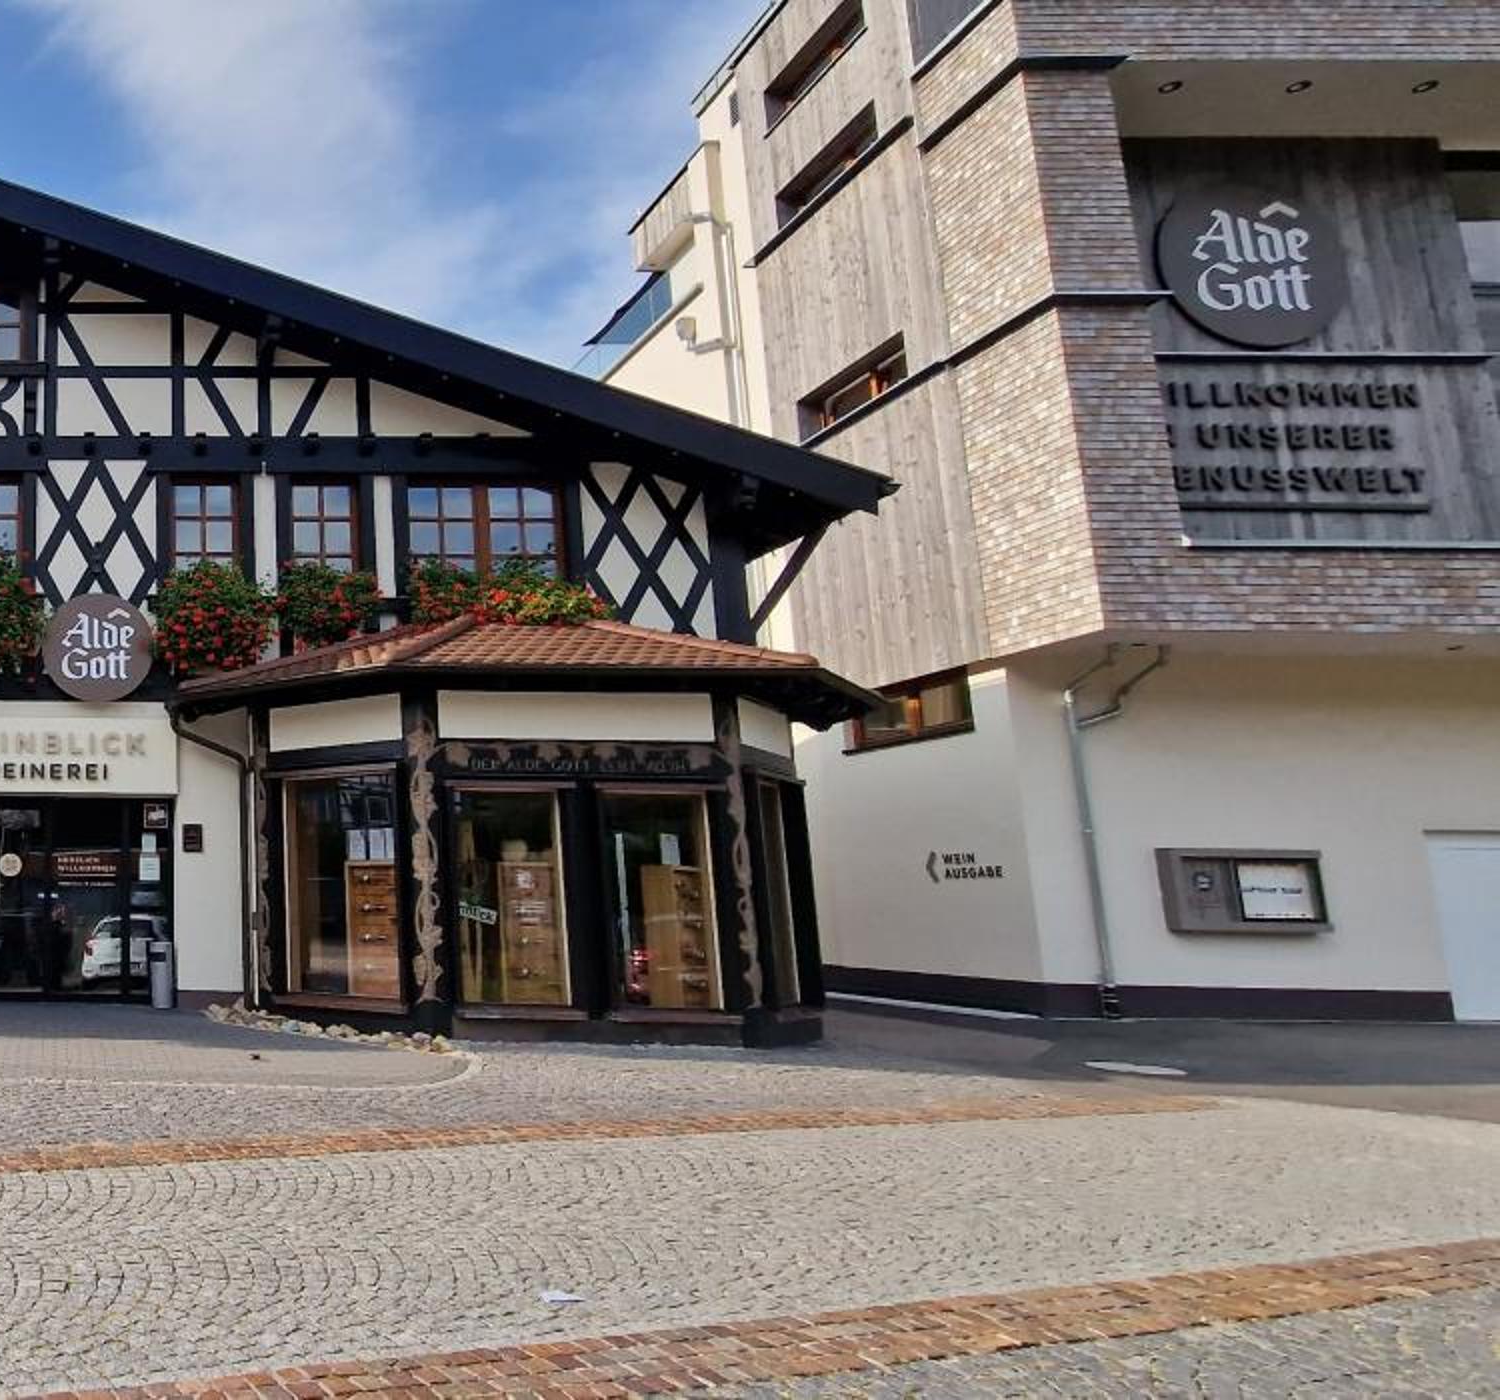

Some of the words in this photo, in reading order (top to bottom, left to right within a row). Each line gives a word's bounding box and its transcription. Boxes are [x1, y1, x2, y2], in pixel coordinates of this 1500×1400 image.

[1197, 262, 1312, 311] Gott
[1165, 382, 1420, 409] ILLKOMMEN
[1196, 423, 1394, 451] UNSERER
[1172, 465, 1425, 494] ENUSSWELT
[61, 647, 132, 679] Gott
[941, 852, 975, 864] WEIN
[944, 865, 1003, 879] AUSGABE
